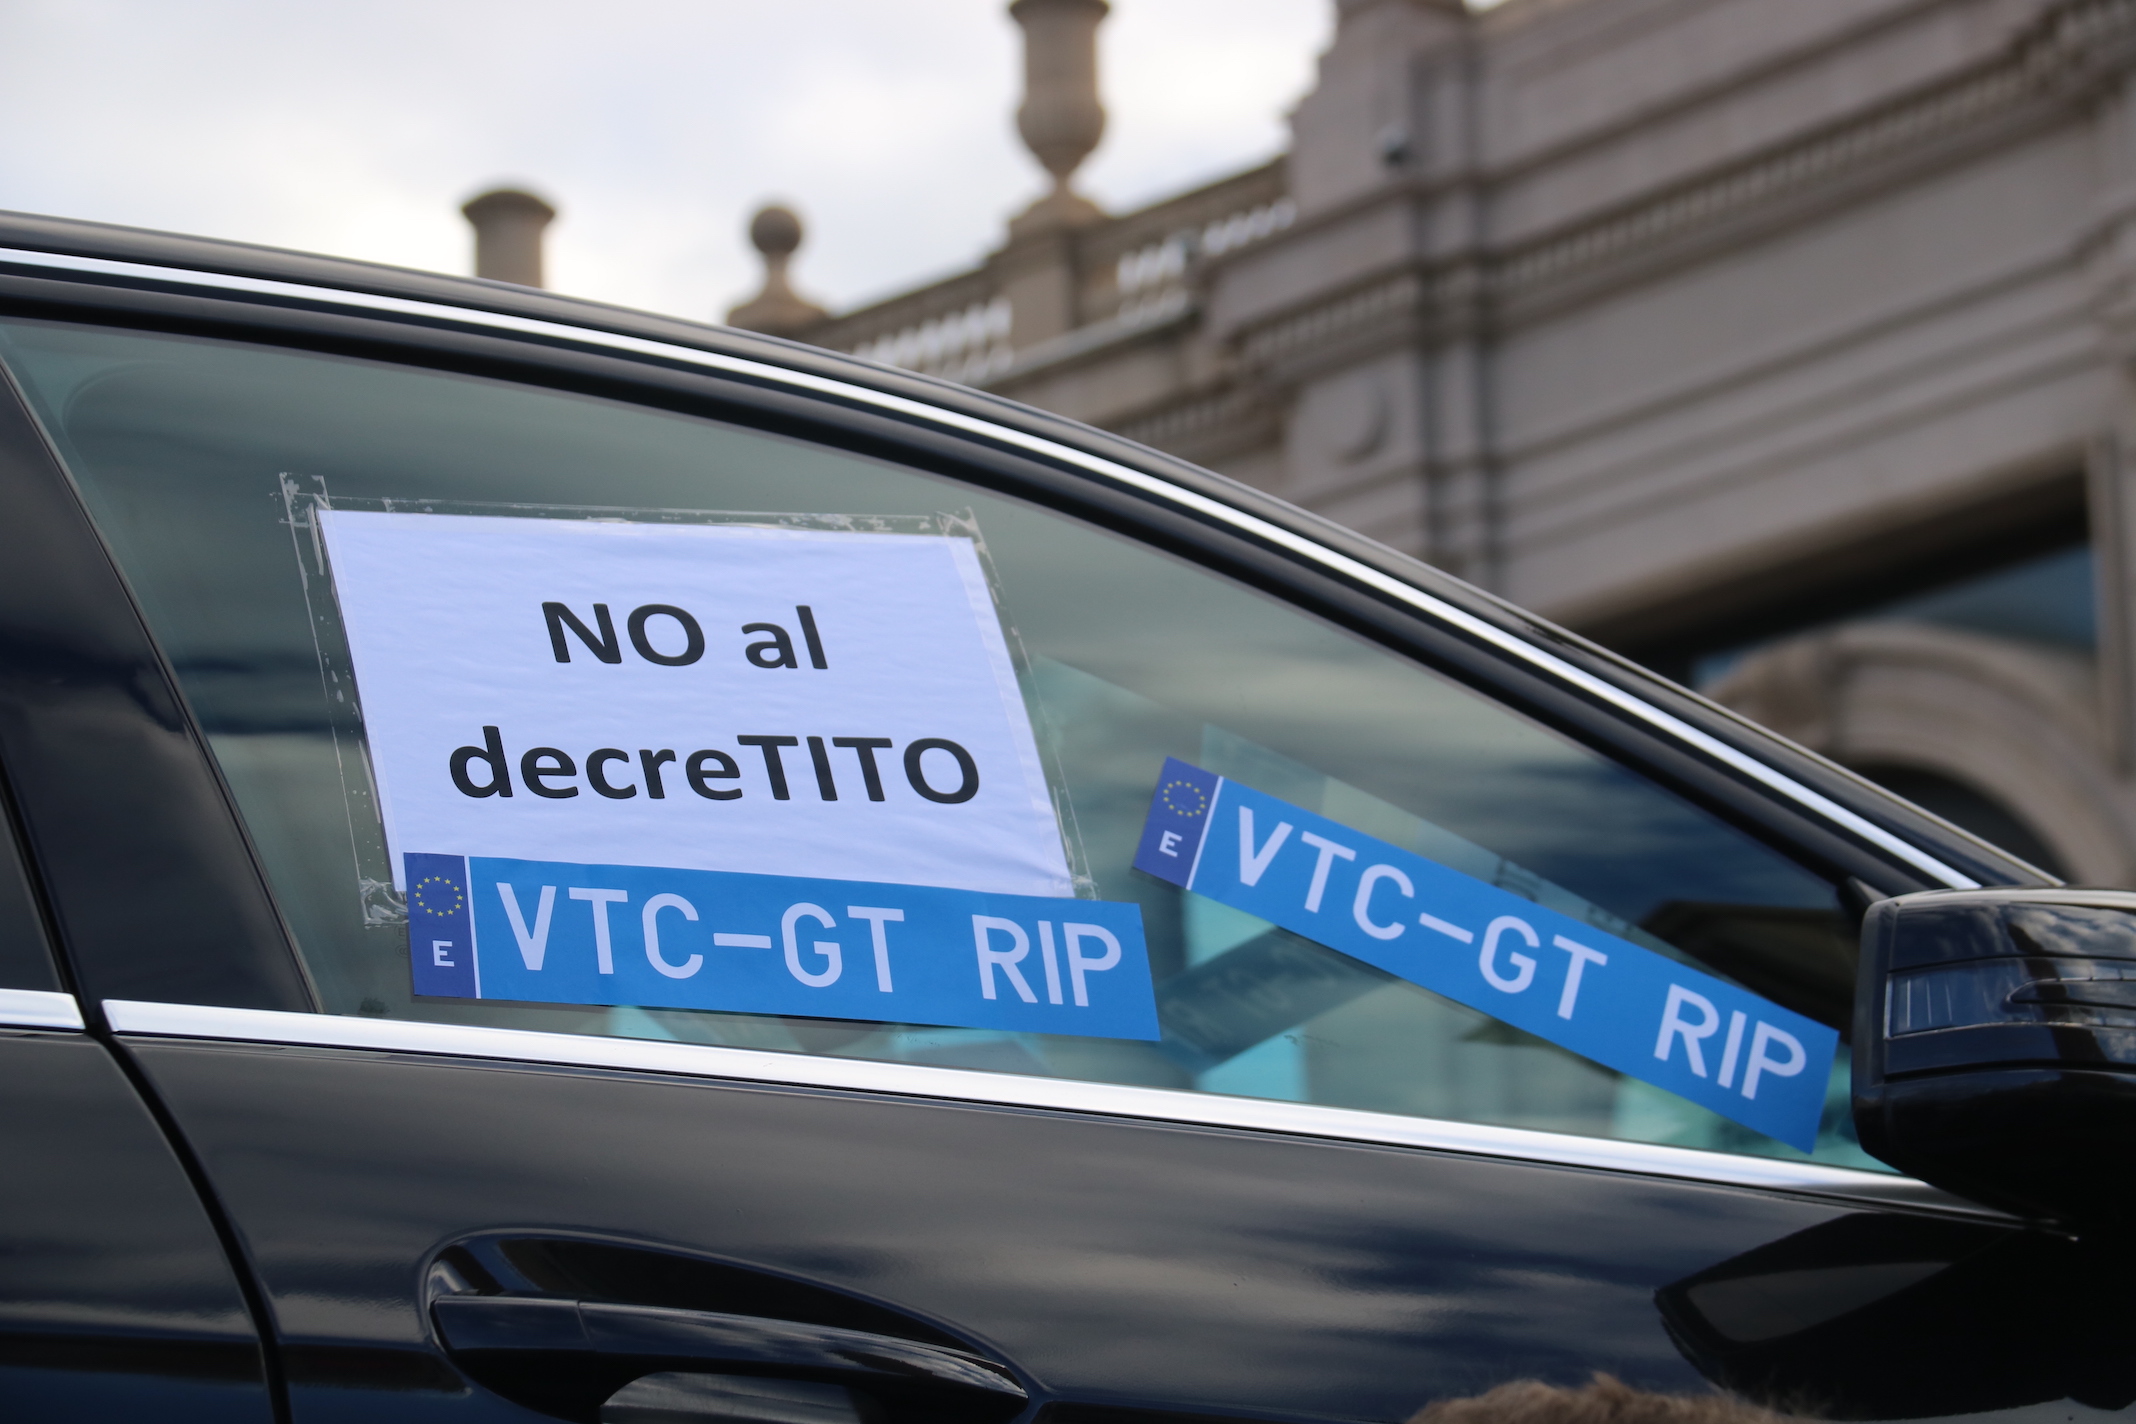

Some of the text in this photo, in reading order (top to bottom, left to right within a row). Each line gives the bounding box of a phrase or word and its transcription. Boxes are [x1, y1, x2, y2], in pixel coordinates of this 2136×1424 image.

[541, 601, 829, 670] NO al
[449, 725, 980, 805] decreTITO
[1159, 830, 1182, 857] E
[432, 940, 455, 967] E
[496, 882, 905, 993] VTC-GT
[971, 914, 1122, 1007] RIP
[1239, 806, 1607, 1020] VTC-GT
[1654, 984, 1805, 1099] RIP
